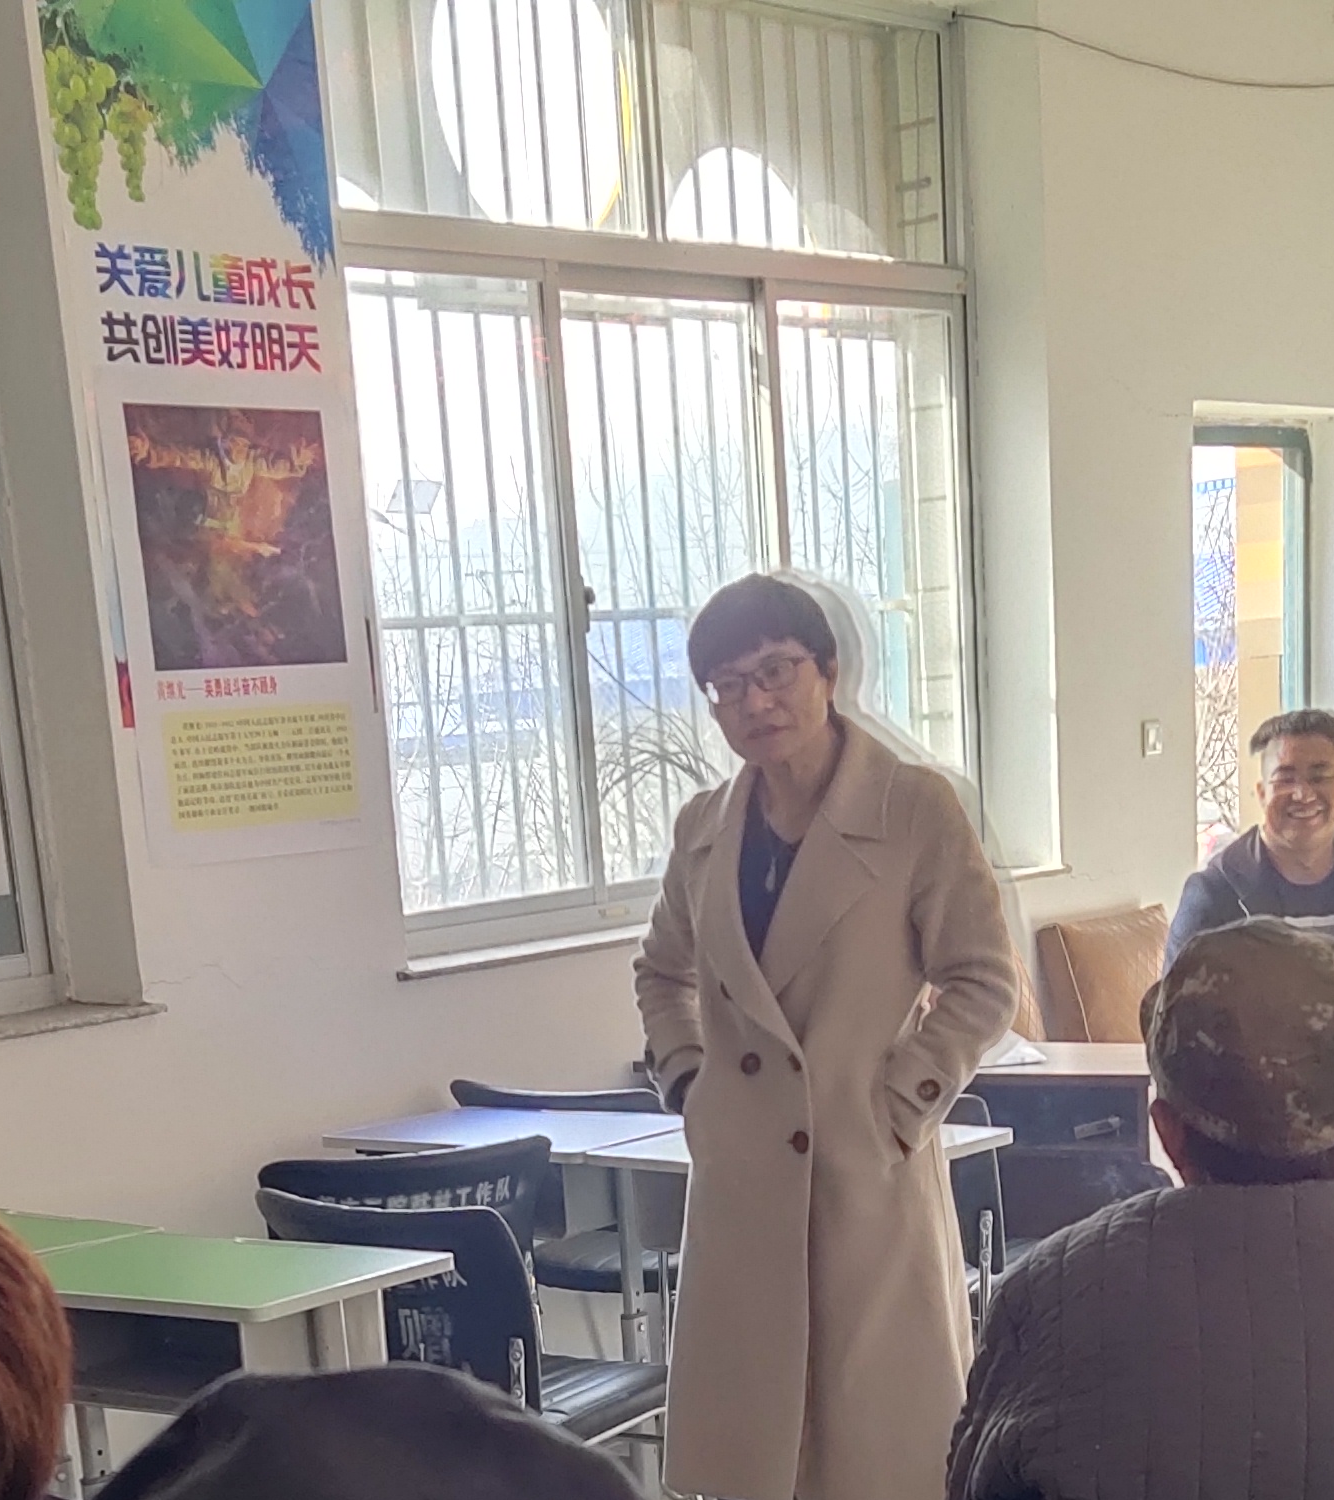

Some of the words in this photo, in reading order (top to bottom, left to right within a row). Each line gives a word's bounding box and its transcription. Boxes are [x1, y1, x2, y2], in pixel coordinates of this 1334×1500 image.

[95, 242, 317, 311] 关爱儿童成长
[101, 311, 322, 373] 共创美好明天
